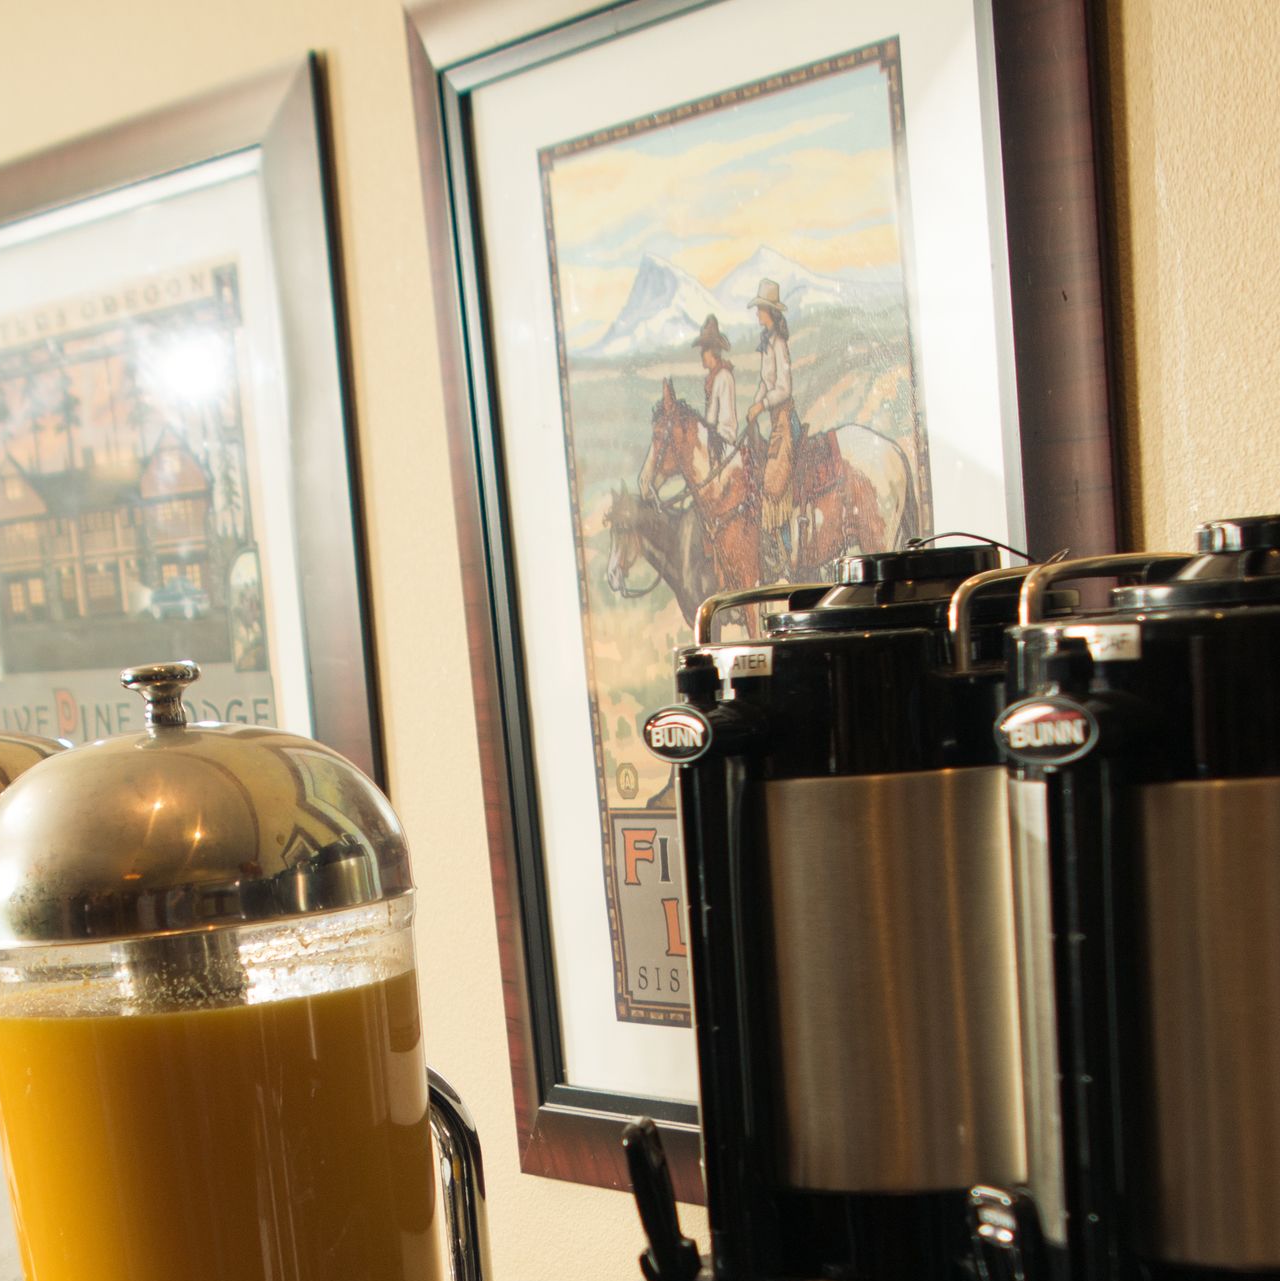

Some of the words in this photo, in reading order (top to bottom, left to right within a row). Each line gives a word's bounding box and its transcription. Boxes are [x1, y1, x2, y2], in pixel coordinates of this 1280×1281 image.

[731, 653, 767, 671] ATER
[54, 687, 131, 742] PINE
[652, 726, 703, 747] BUNN
[1009, 718, 1084, 748] BUNN
